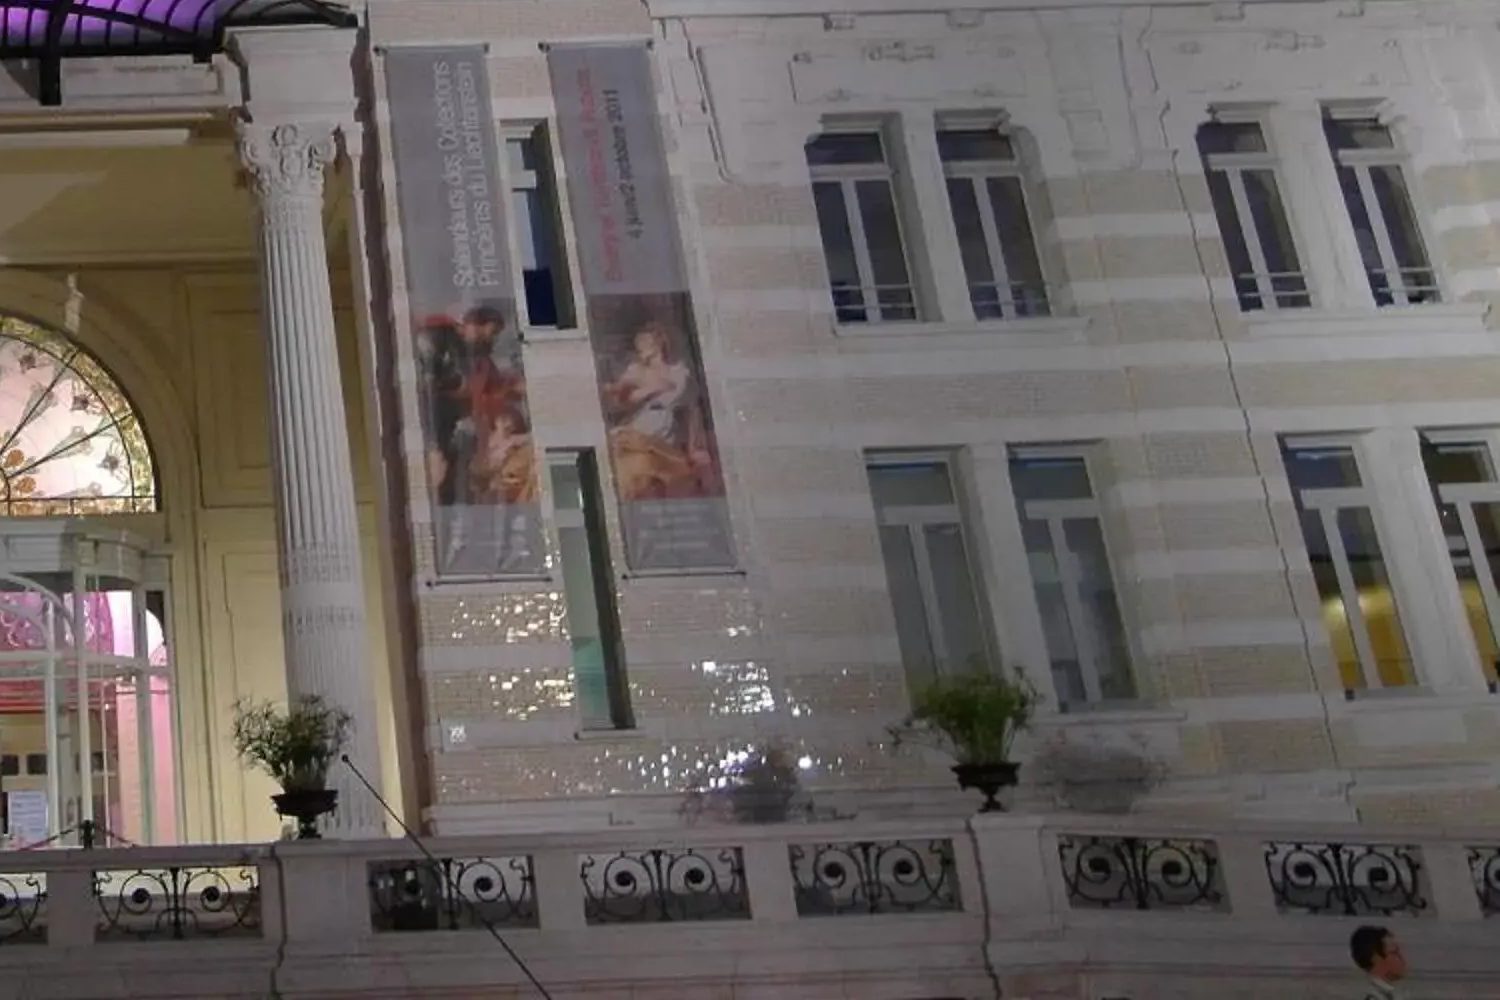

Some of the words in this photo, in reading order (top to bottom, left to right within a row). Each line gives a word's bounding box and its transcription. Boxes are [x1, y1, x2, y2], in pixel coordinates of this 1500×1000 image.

[434, 60, 458, 150] Collections
[458, 61, 485, 169] Liechtenstein
[601, 90, 623, 123] 2011
[443, 154, 462, 185] des
[468, 173, 488, 196] du
[448, 187, 473, 287] Splendeurs
